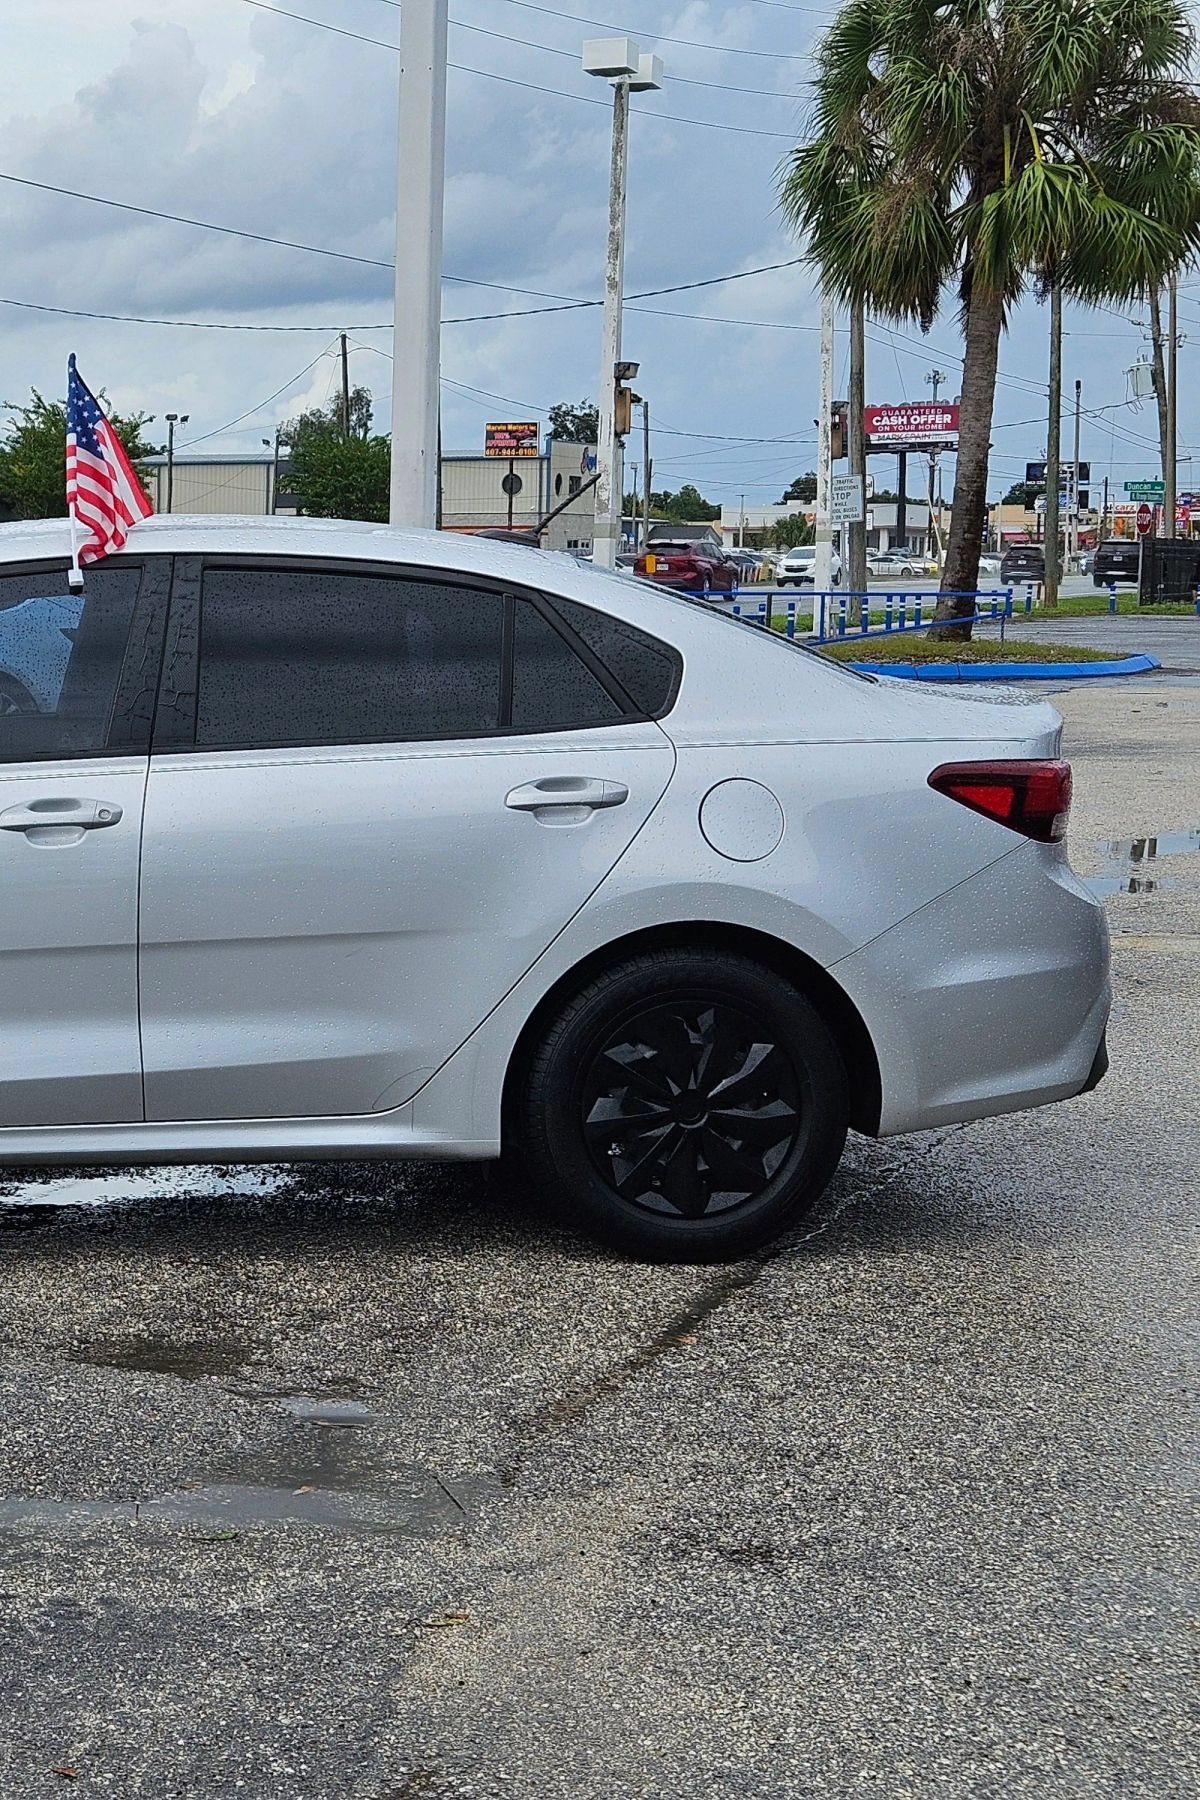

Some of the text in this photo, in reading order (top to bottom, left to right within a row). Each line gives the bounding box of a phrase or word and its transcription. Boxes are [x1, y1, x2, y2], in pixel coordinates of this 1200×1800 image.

[872, 414, 952, 426] CASH OFFER
[485, 448, 537, 456] 407-944-0100
[1127, 482, 1152, 490] Duncan
[1137, 513, 1151, 524] STOP
